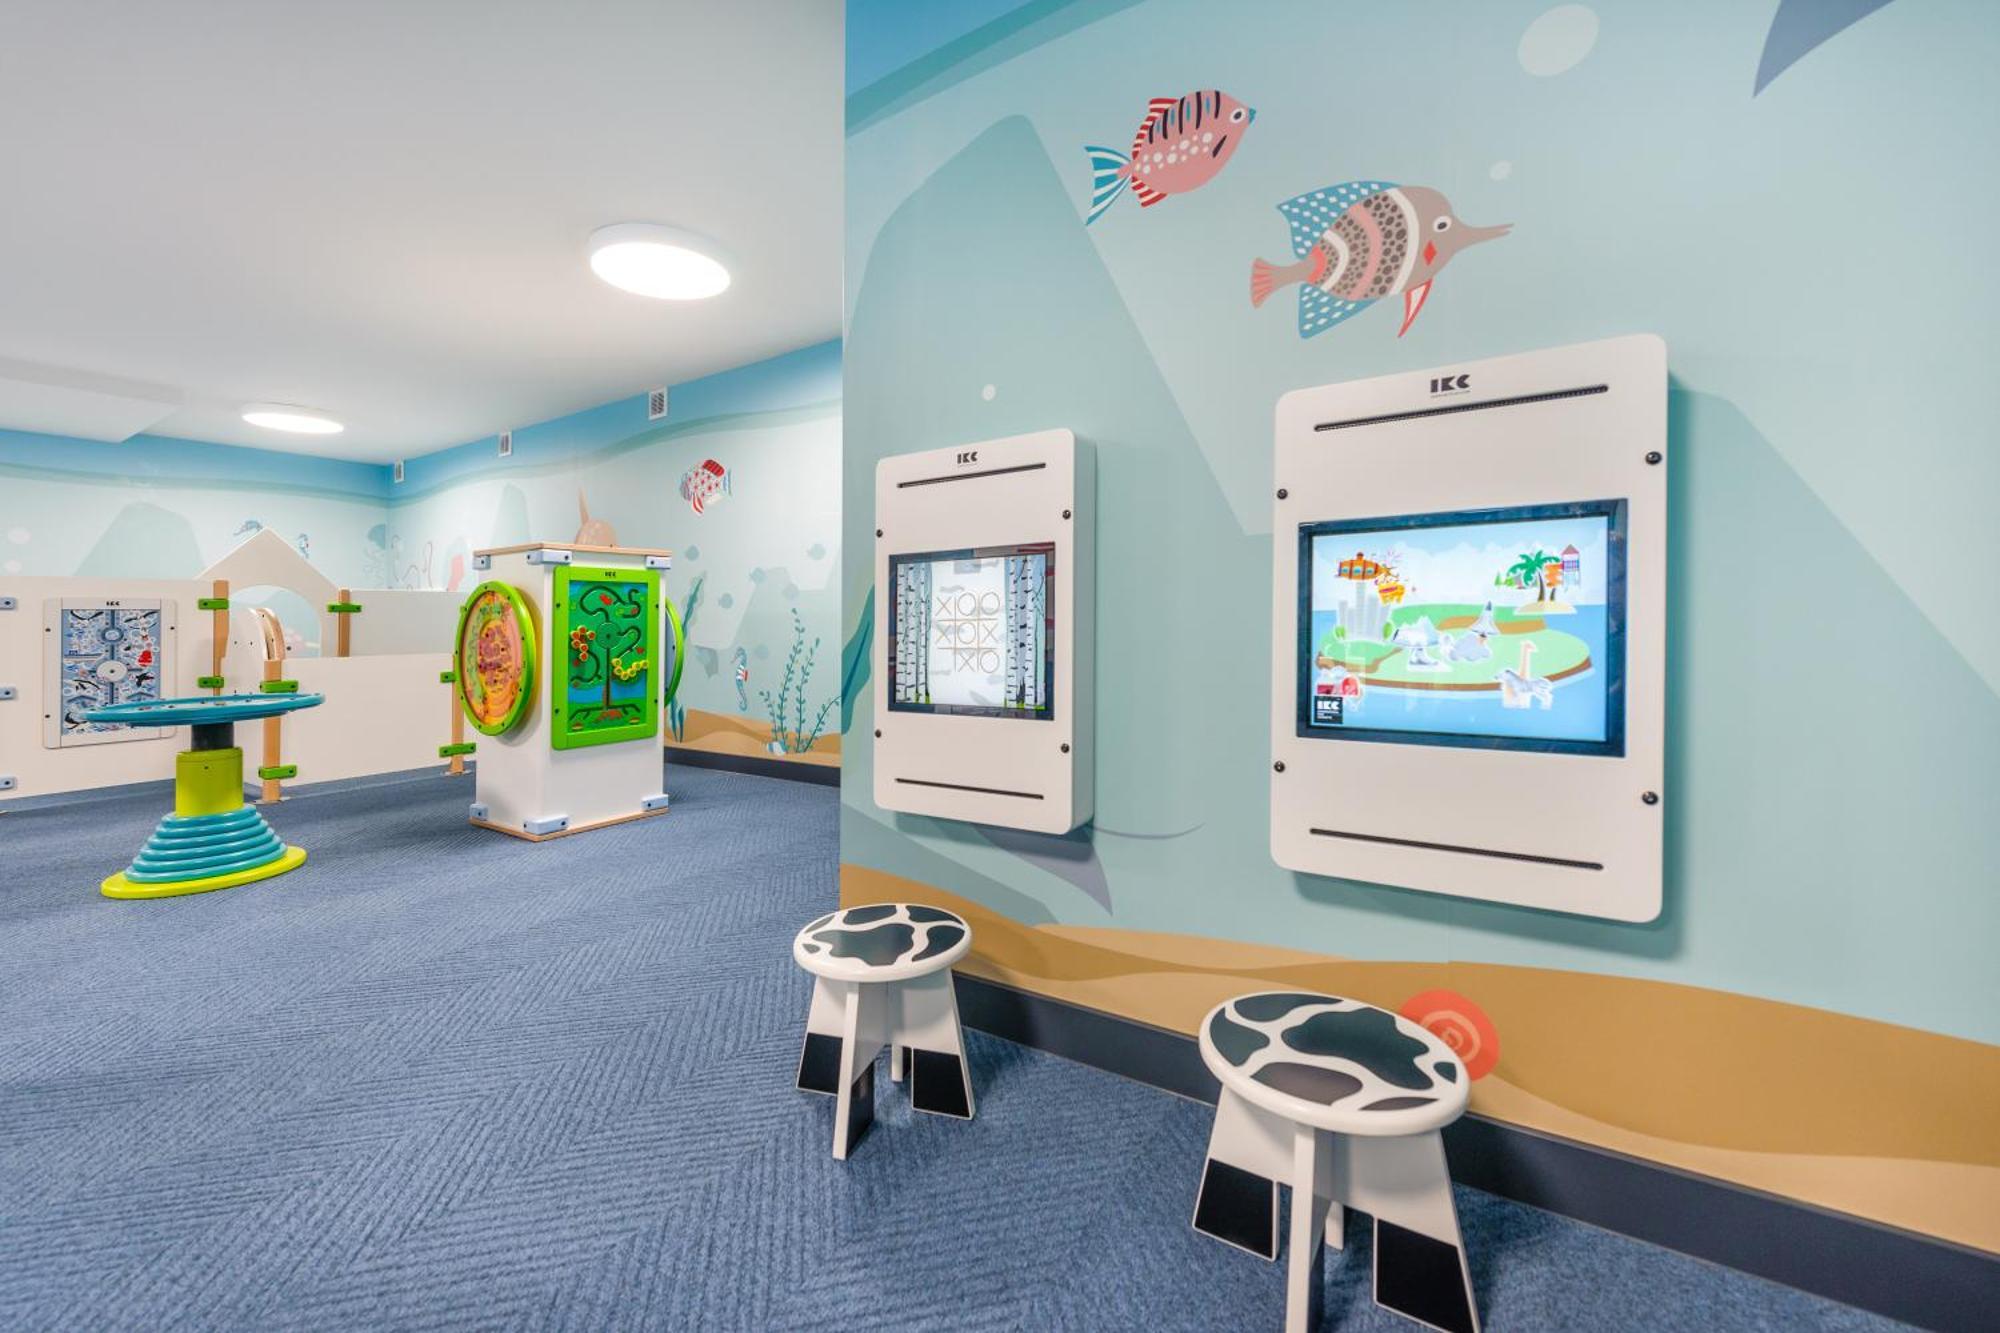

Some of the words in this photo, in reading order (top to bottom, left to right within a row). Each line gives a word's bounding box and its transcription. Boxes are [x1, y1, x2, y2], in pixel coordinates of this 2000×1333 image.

[1430, 374, 1470, 393] IKC
[957, 451, 978, 464] IKC
[1317, 700, 1340, 710] IKC
